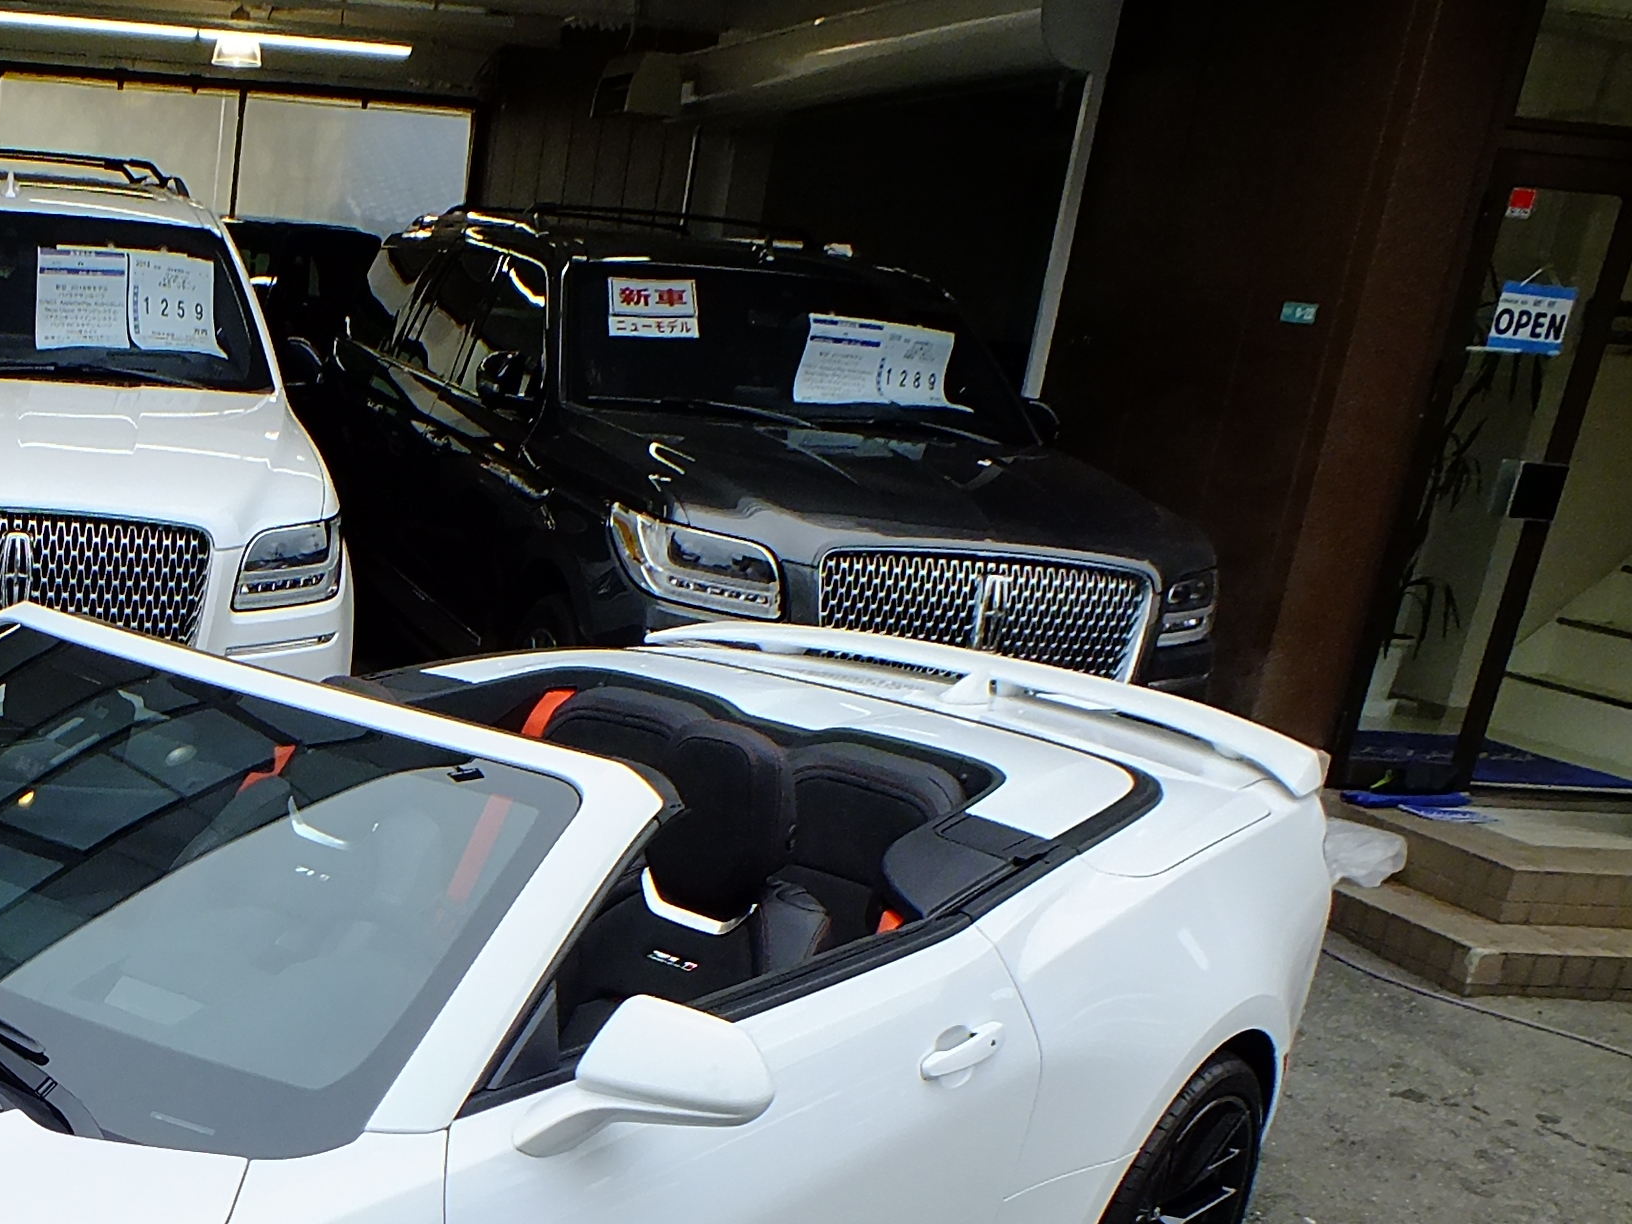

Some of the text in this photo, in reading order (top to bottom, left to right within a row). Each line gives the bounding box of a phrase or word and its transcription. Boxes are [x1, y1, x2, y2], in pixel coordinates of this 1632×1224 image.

[144, 296, 203, 321] 1259
[619, 286, 687, 307] 新車
[616, 319, 691, 334] ニューモデル
[1494, 308, 1566, 341] OPEN
[886, 367, 936, 391] 1289
